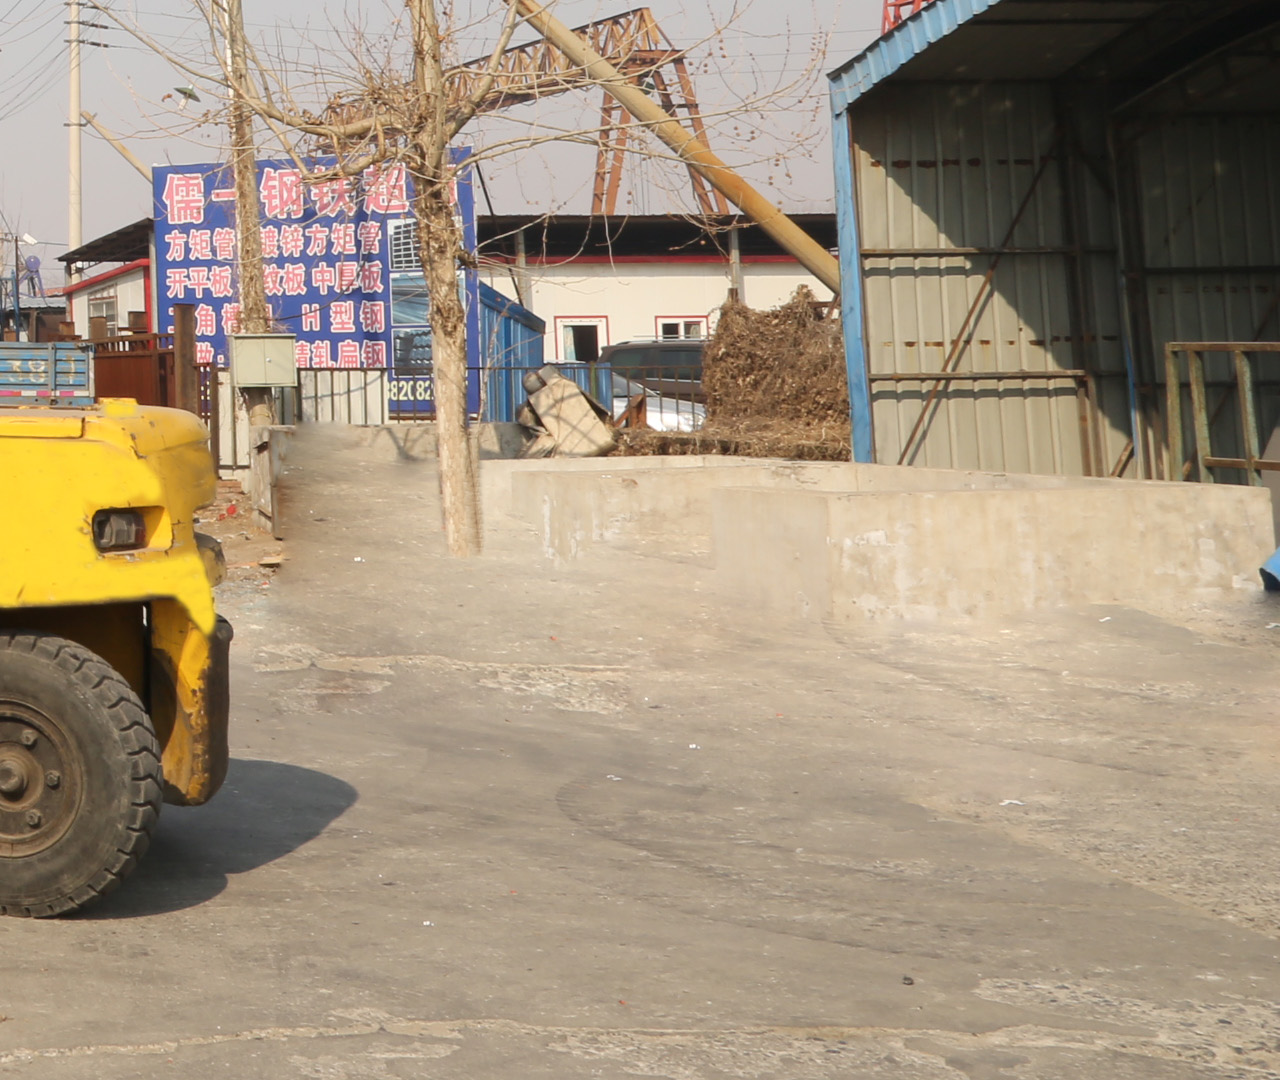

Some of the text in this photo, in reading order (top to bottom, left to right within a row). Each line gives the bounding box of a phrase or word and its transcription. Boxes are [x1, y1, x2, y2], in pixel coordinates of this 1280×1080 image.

[162, 163, 458, 224] 儒一钢铁超
[165, 228, 234, 261] 方矩管
[166, 266, 234, 299] 开平板
[311, 260, 384, 296] 中厚板
